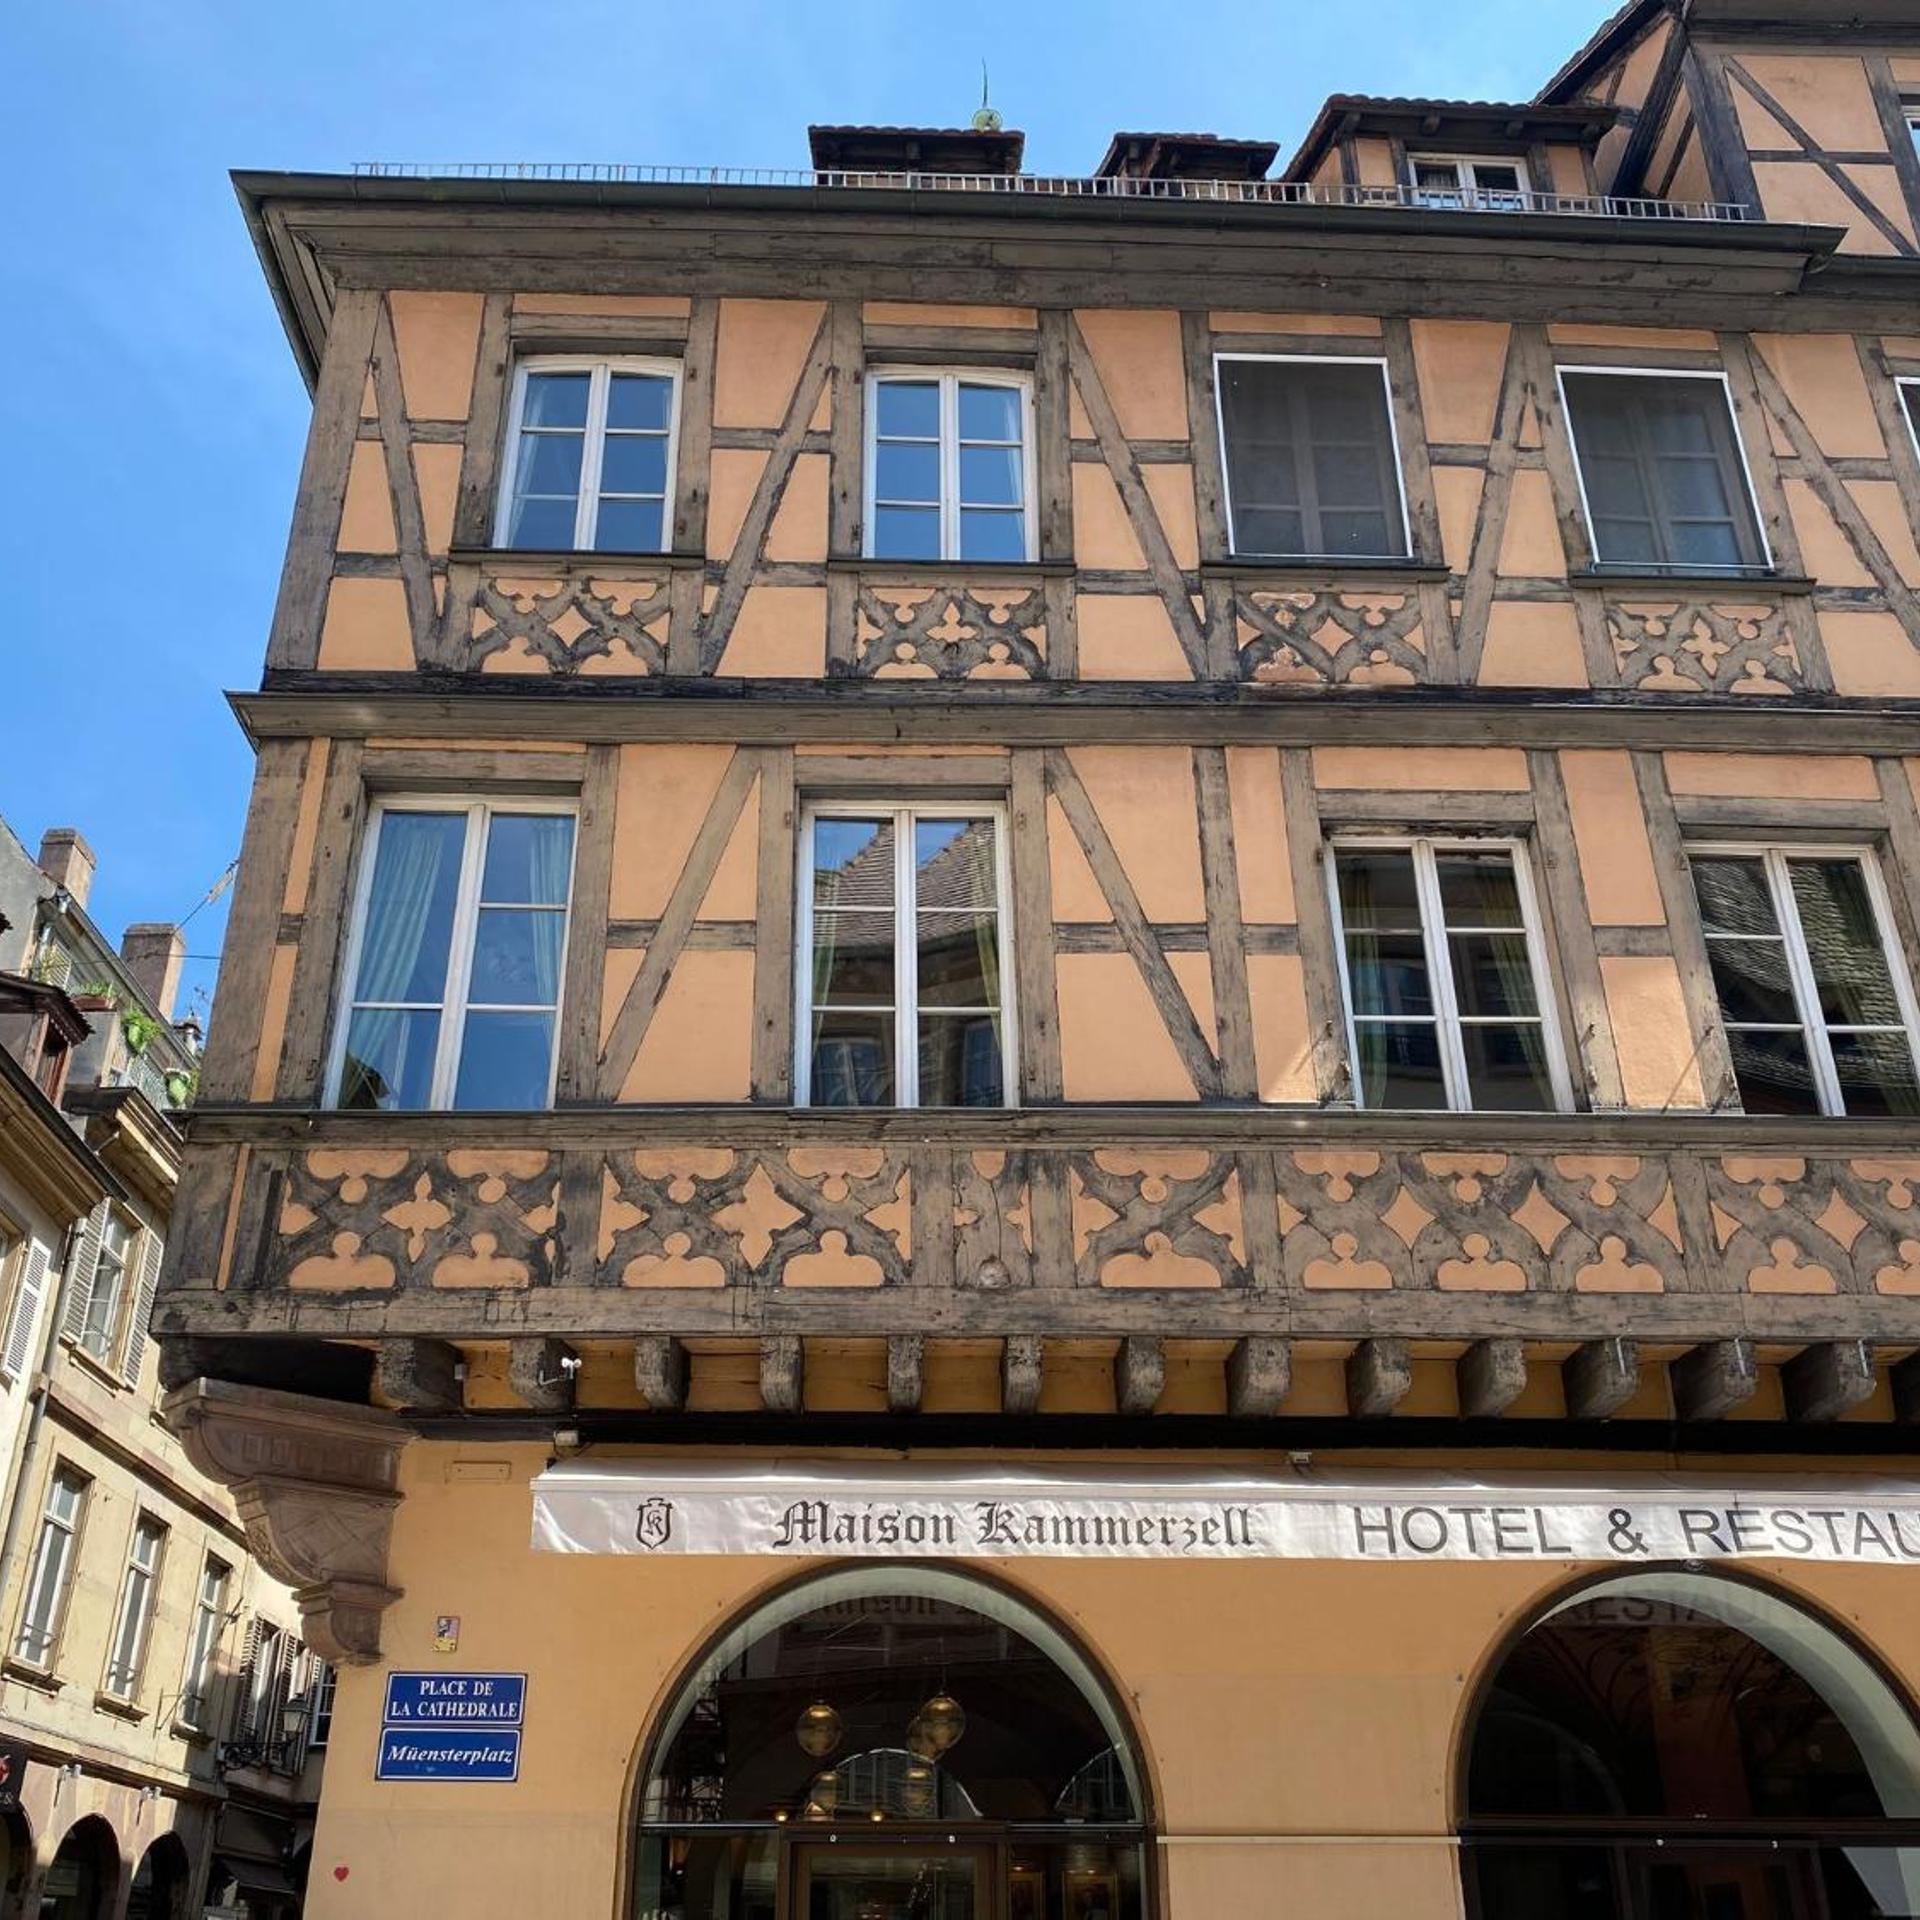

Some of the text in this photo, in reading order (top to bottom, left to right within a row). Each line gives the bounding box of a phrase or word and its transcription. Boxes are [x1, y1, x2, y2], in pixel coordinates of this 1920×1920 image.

[773, 1501, 1254, 1552] Maison Kammerzell
[1354, 1507, 1571, 1554] HOTEL
[1608, 1508, 1649, 1554] &
[420, 1681, 494, 1695] PLACE DE
[391, 1702, 517, 1718] LA CATHEDRALE
[387, 1745, 513, 1765] Müensterplatz
